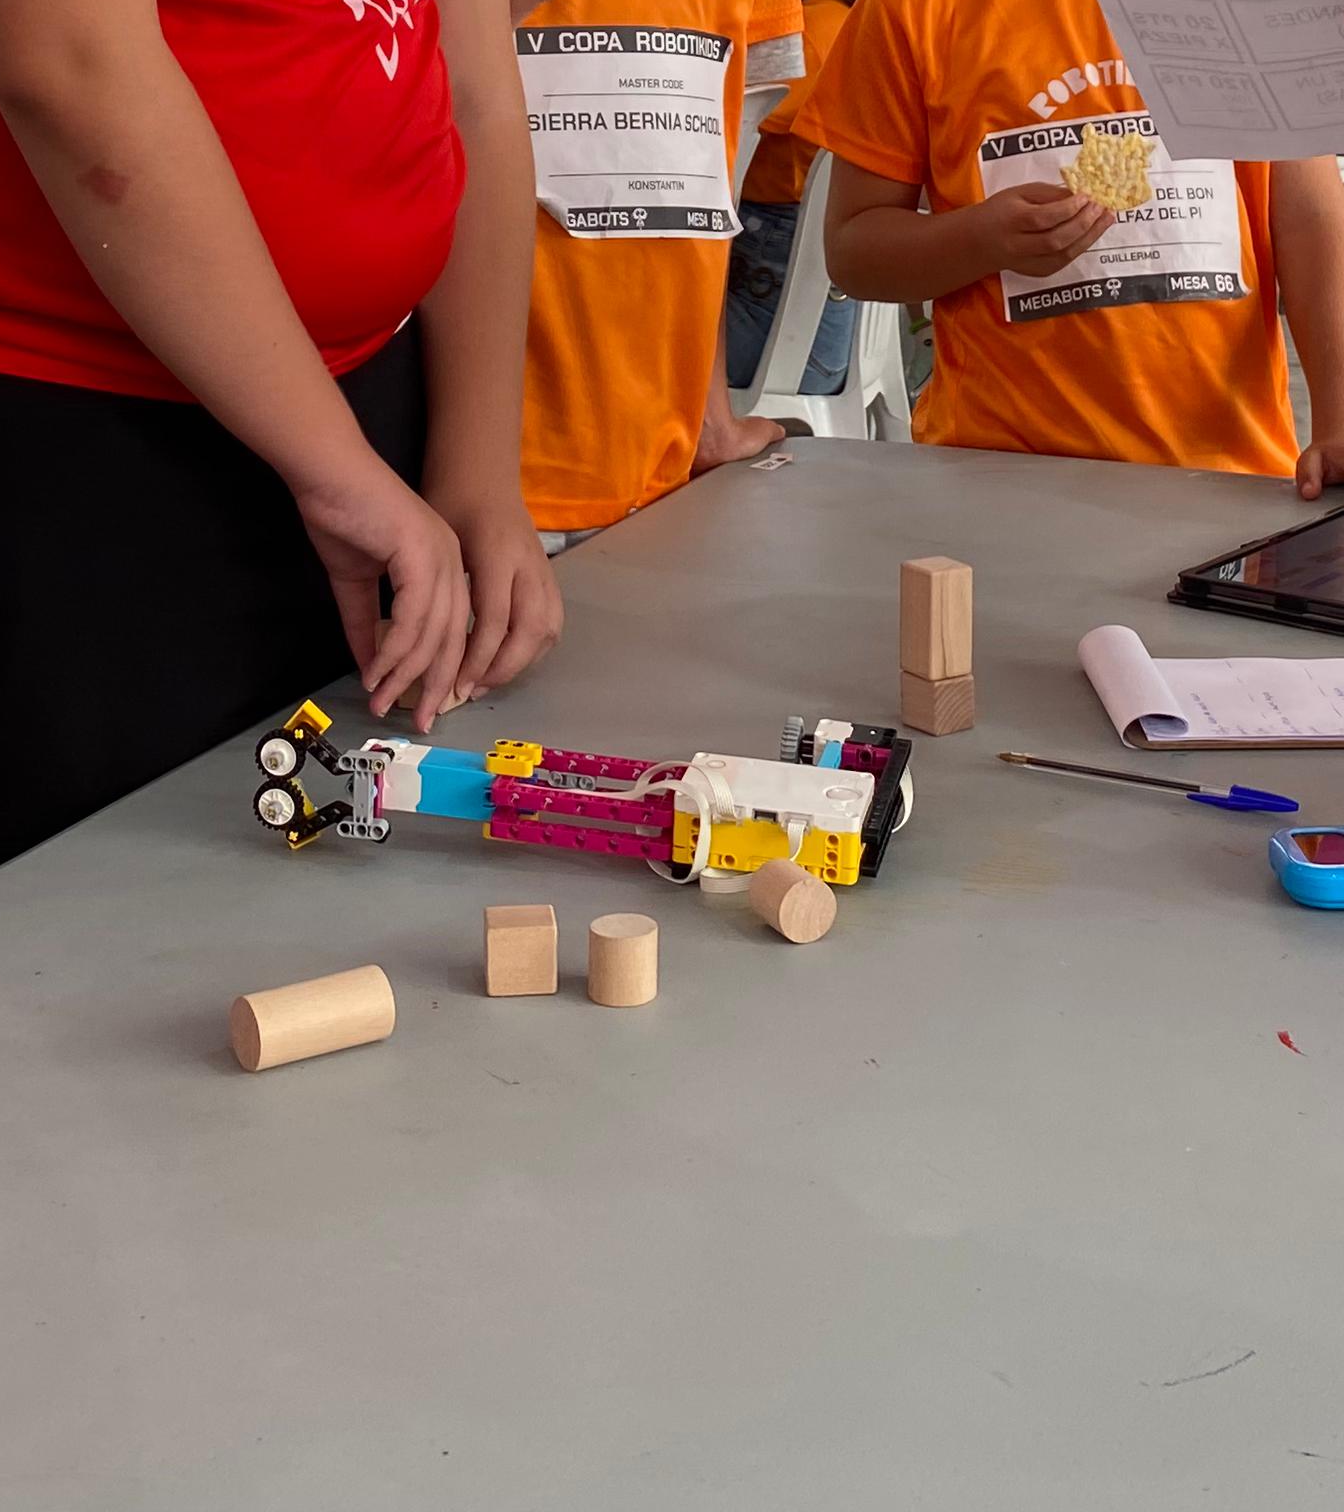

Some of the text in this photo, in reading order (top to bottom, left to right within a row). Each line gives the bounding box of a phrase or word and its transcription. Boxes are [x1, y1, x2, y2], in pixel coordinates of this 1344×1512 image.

[527, 31, 722, 60] V COPA ROBOTIKIDS
[618, 77, 684, 90] MASTER CODE
[527, 111, 722, 136] SIERRA BERNIA SCHOOL
[990, 140, 1006, 158] V
[1018, 127, 1080, 152] COPA
[628, 180, 685, 191] KONSTANTIN
[1155, 186, 1214, 201] DEL BON
[687, 212, 709, 228] MESA
[711, 212, 724, 231] 66
[1113, 206, 1202, 224] LFAZ DEL PI
[1099, 250, 1161, 265] GUILLERMO
[1019, 274, 1235, 312] MEGABOTS MESA 66
